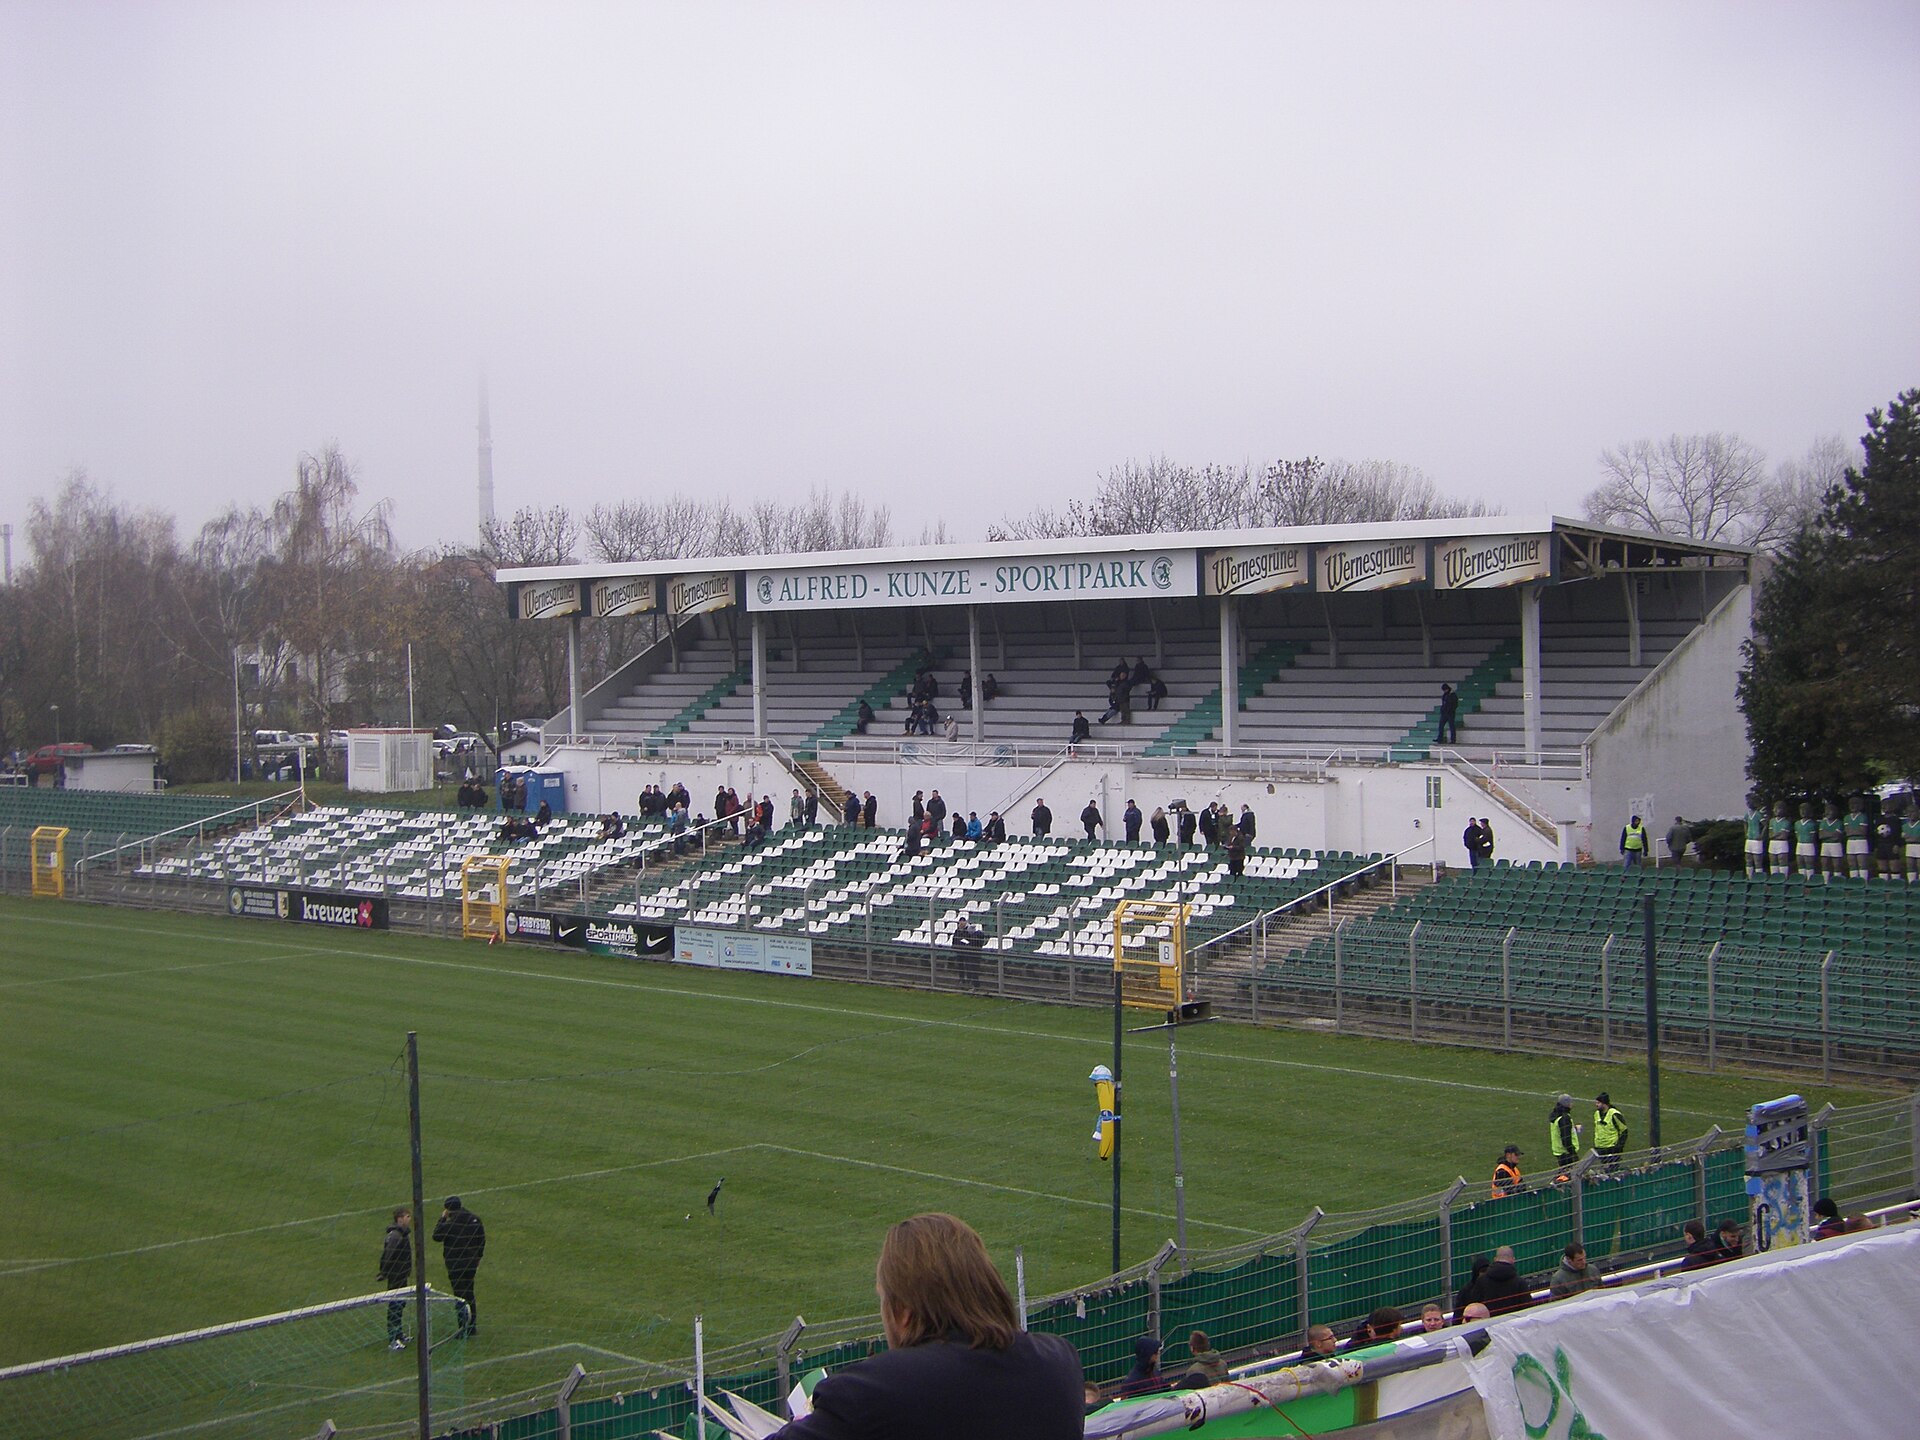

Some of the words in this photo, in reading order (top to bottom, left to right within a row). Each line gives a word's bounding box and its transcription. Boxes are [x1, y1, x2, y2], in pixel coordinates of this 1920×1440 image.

[778, 574, 867, 602] ALFRED
[887, 569, 972, 598] KUNZE
[995, 560, 1148, 593] SPORTPARK
[1212, 547, 1300, 594] Wernesgrüner
[1324, 542, 1416, 592] Wernesgrüner
[1443, 538, 1541, 589] Wernesgrüner
[522, 582, 576, 617] Wernesgrüner
[595, 578, 650, 616] Wernesgrüner
[672, 575, 729, 614] Wernesgrüner
[302, 896, 358, 924] kreuzer
[586, 929, 638, 944] SPORTHAUS
